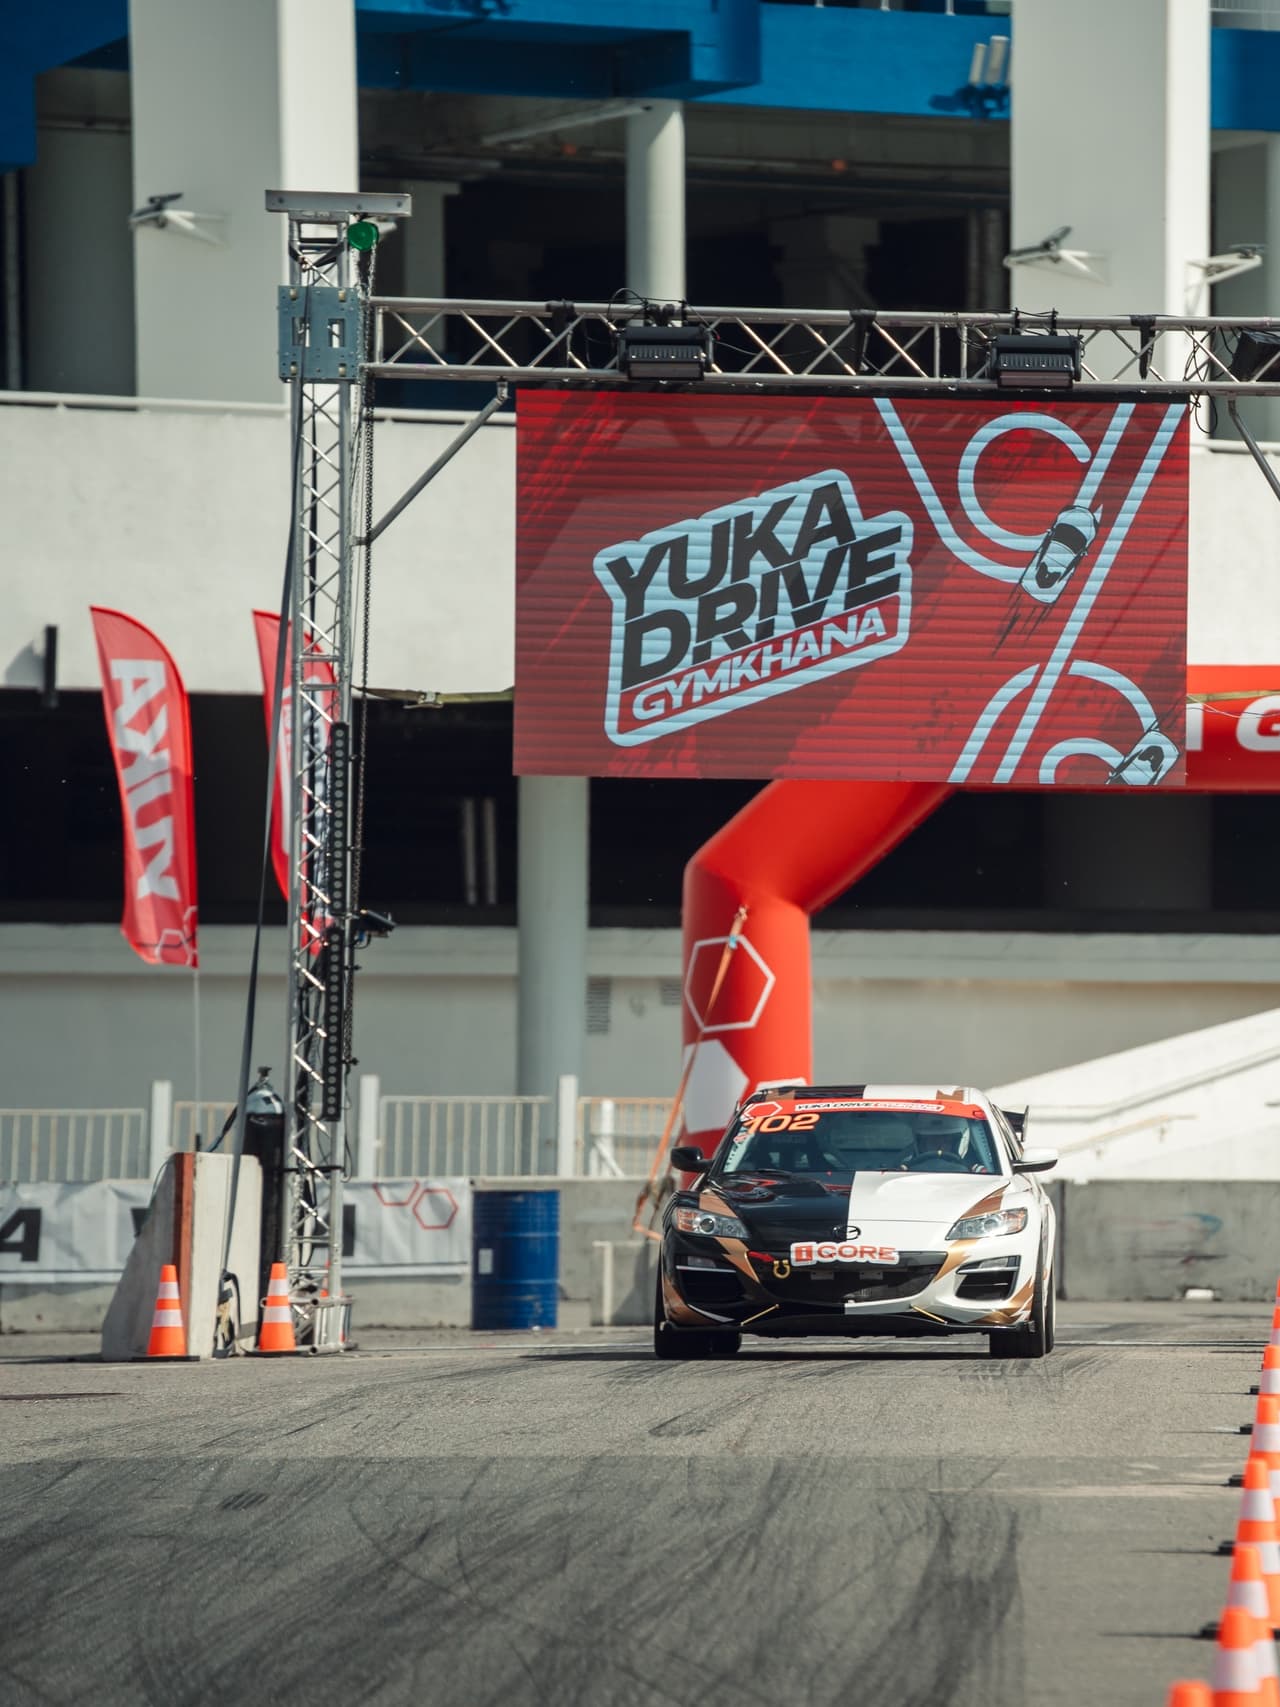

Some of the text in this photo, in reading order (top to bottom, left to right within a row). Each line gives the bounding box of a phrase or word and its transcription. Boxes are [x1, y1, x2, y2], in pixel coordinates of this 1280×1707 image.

[605, 480, 856, 622] YUKA
[621, 525, 903, 691] DRIVE
[631, 605, 887, 721] GYMKHANA
[743, 1113, 820, 1134] 102
